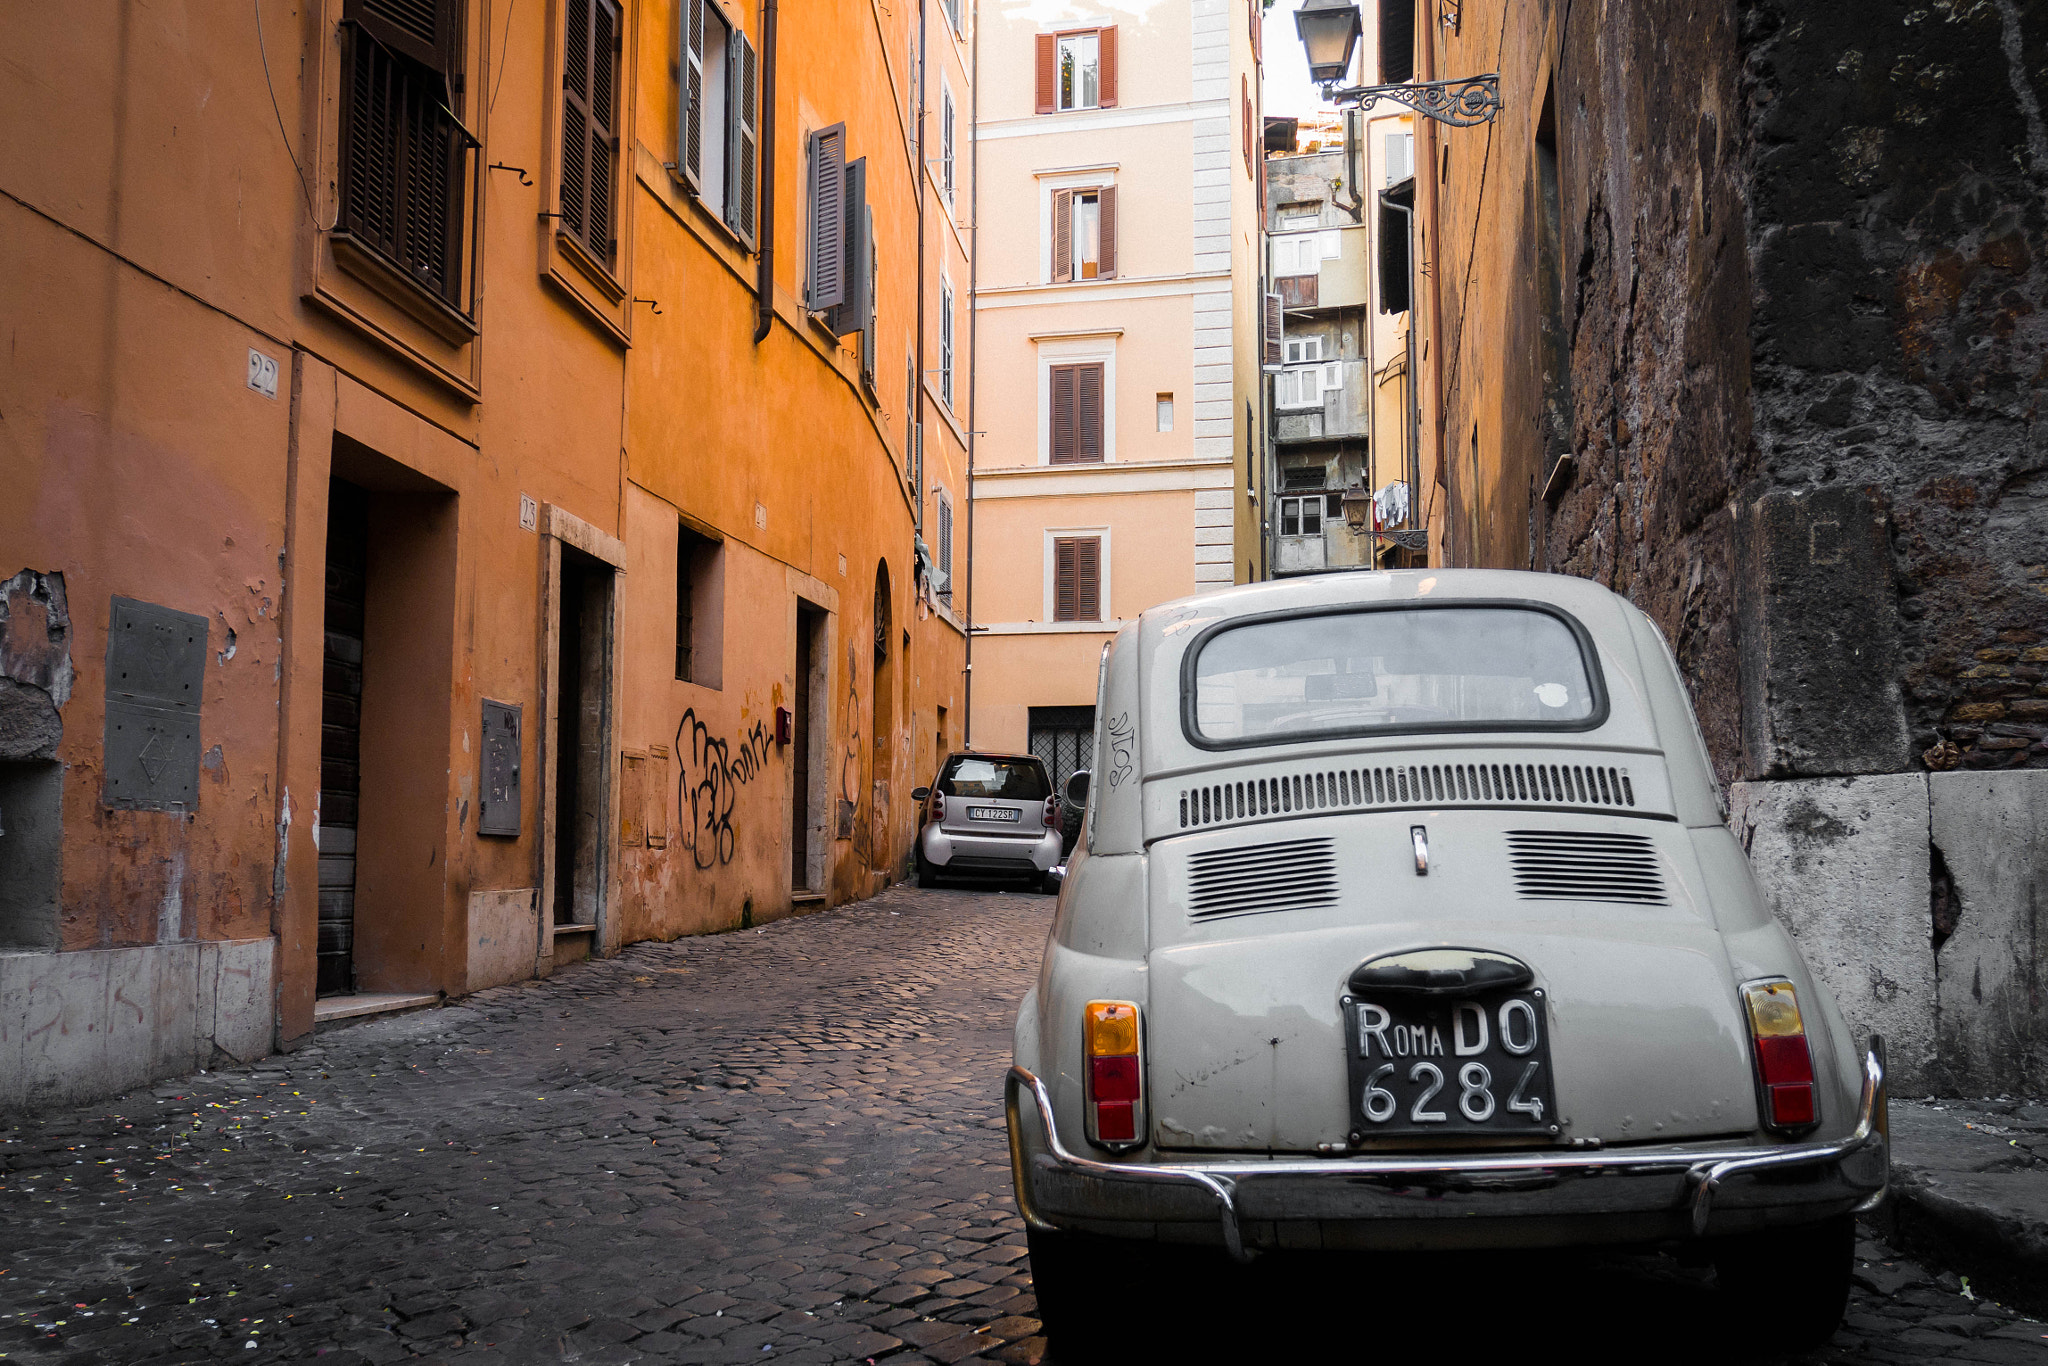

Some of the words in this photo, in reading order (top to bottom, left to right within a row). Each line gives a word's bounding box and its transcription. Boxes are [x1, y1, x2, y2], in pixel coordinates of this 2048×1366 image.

[251, 353, 276, 395] 22
[522, 498, 535, 527] 23
[1360, 1061, 1544, 1122] 6284
